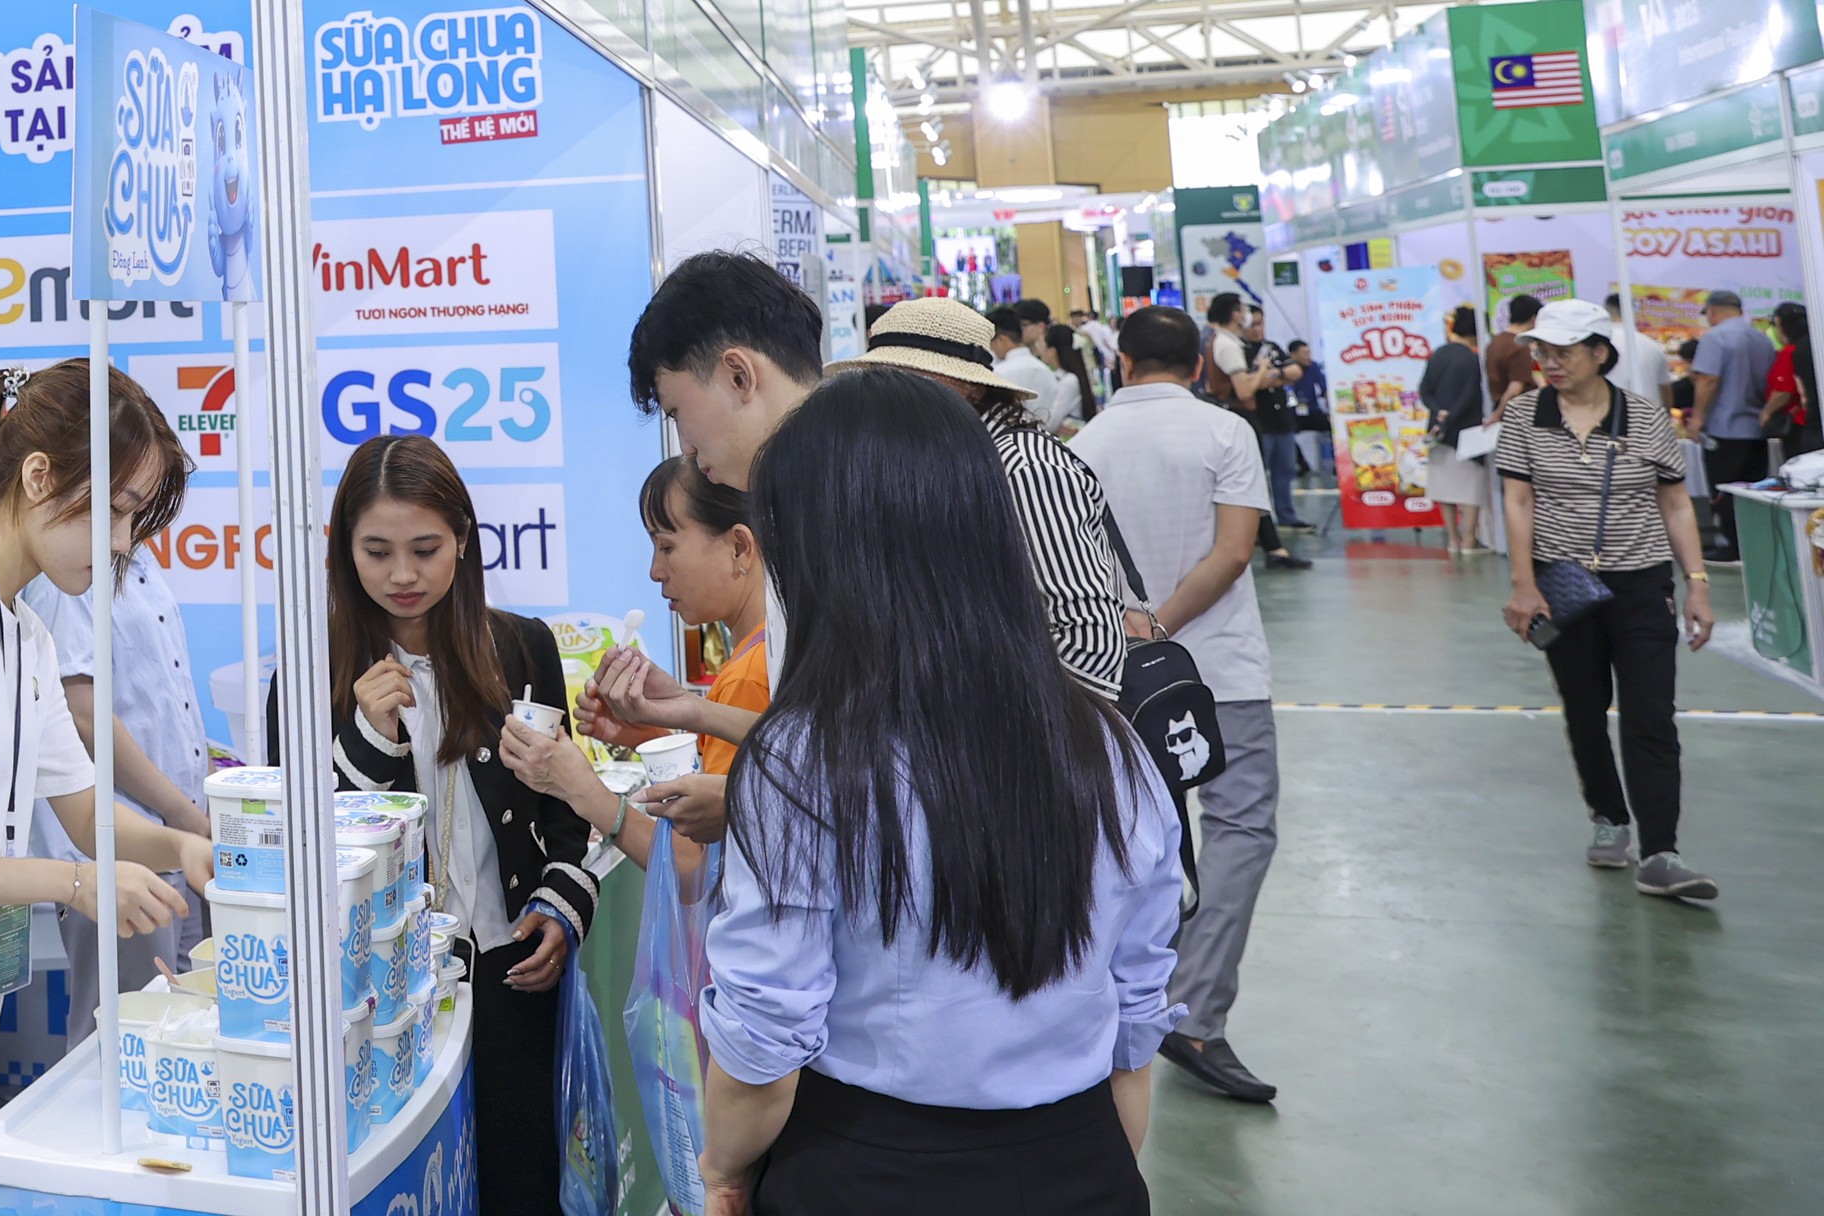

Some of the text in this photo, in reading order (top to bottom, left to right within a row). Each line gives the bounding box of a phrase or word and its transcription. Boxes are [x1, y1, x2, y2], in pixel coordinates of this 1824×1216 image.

[321, 12, 536, 70] SỮA CHUA
[118, 55, 175, 154] SỮA
[322, 57, 536, 125] HẠ LONG
[5, 105, 67, 152] TẠI
[440, 114, 535, 142] THẾ HỆ MỚI
[104, 149, 192, 275] CHUA
[1684, 229, 1782, 258] ASAHI
[389, 306, 427, 320] NGON
[430, 303, 485, 322] THƯỢNG
[1362, 326, 1432, 359] 10%
[321, 364, 553, 445] GS25
[221, 933, 269, 964] SỮA
[217, 960, 289, 1001] CHUA
[222, 985, 247, 998] Yogurt
[155, 1057, 199, 1085] SỮA
[151, 1080, 219, 1117] CHUA
[156, 1103, 178, 1115] Yogurt
[229, 1082, 277, 1113] SỮA
[226, 1108, 295, 1150] CHUA
[230, 1134, 254, 1147] Yogurt
